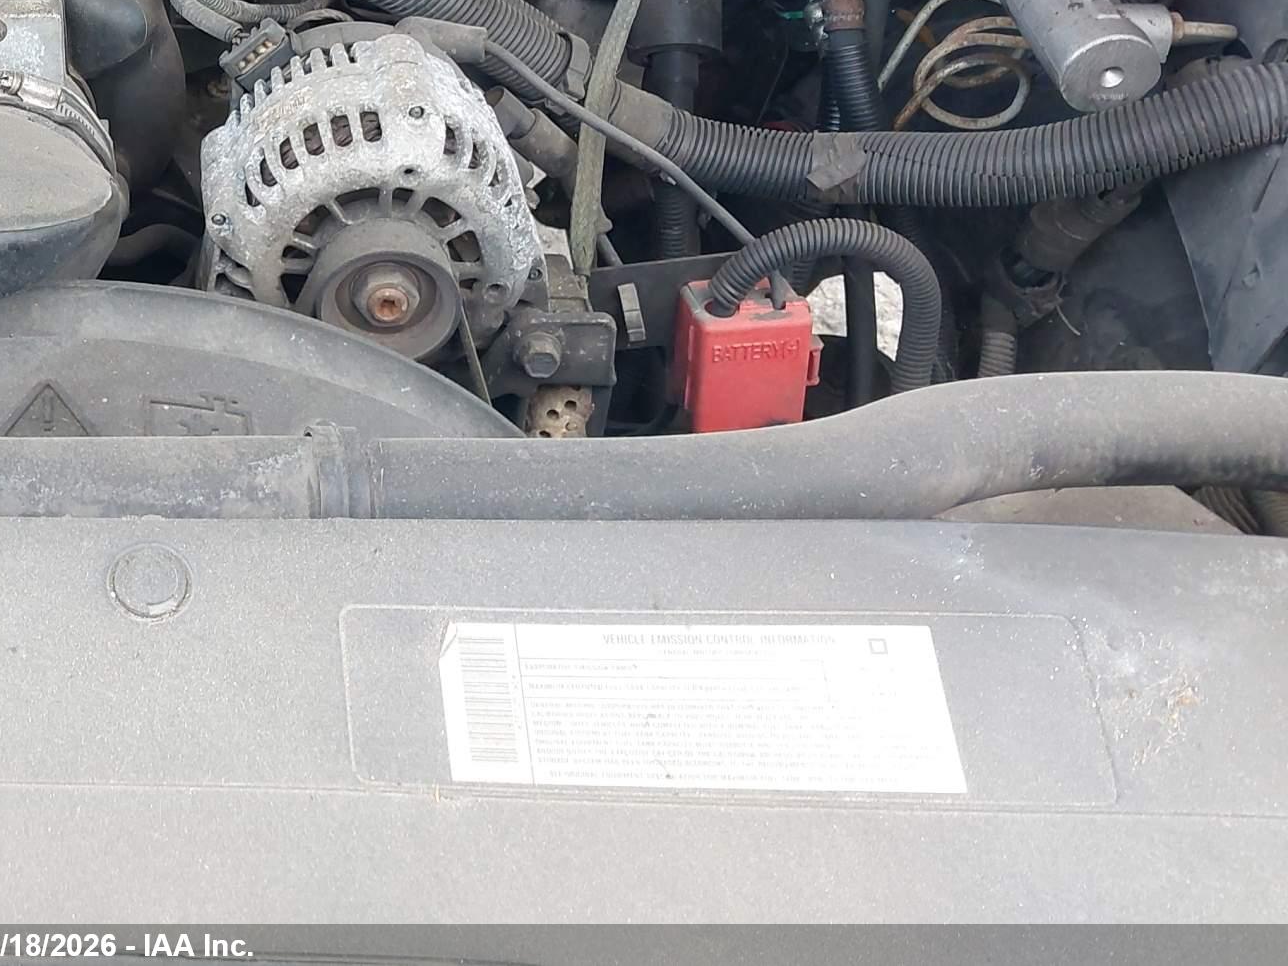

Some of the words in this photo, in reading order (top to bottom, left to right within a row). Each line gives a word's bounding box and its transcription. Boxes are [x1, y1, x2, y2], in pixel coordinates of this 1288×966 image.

[712, 340, 781, 363] BATTERY
[601, 633, 646, 645] VEHICLE
[650, 633, 703, 645] EMISSION
[706, 633, 753, 645] CONTROL
